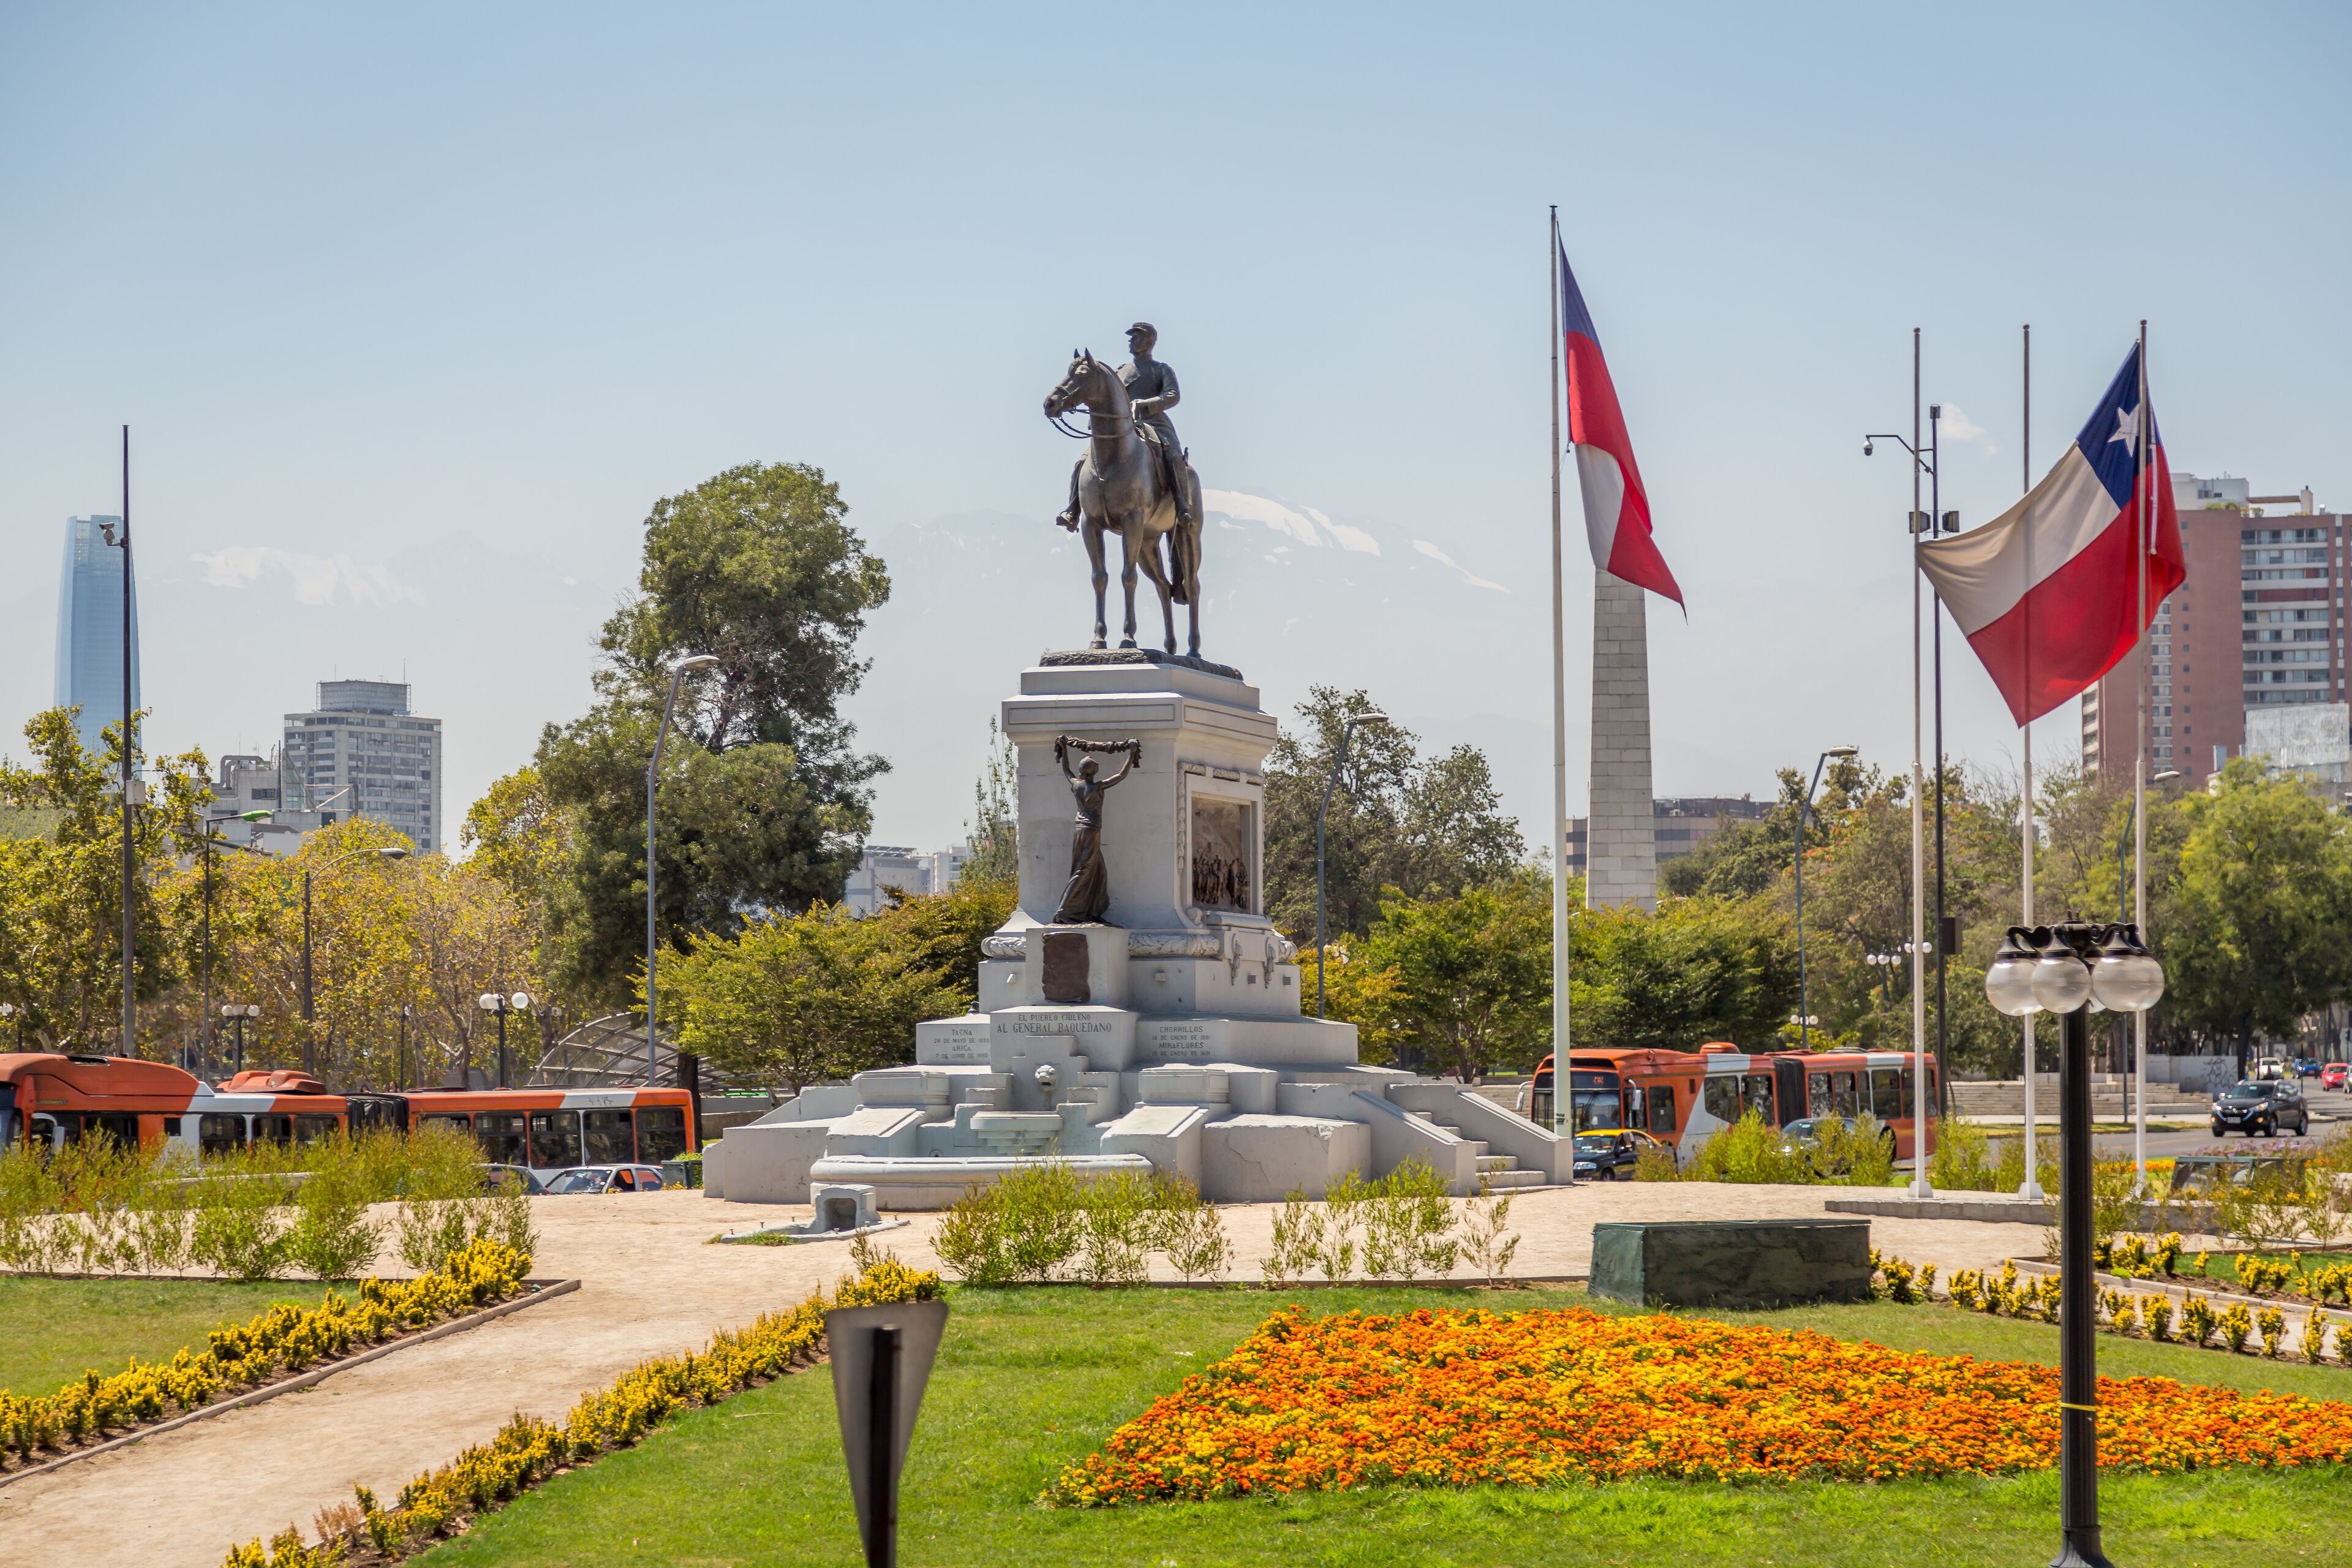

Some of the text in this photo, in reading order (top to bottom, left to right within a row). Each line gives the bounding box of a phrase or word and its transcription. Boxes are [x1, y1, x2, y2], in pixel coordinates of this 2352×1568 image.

[997, 1022, 1112, 1033] AL GENERAL BAQUEDANO
